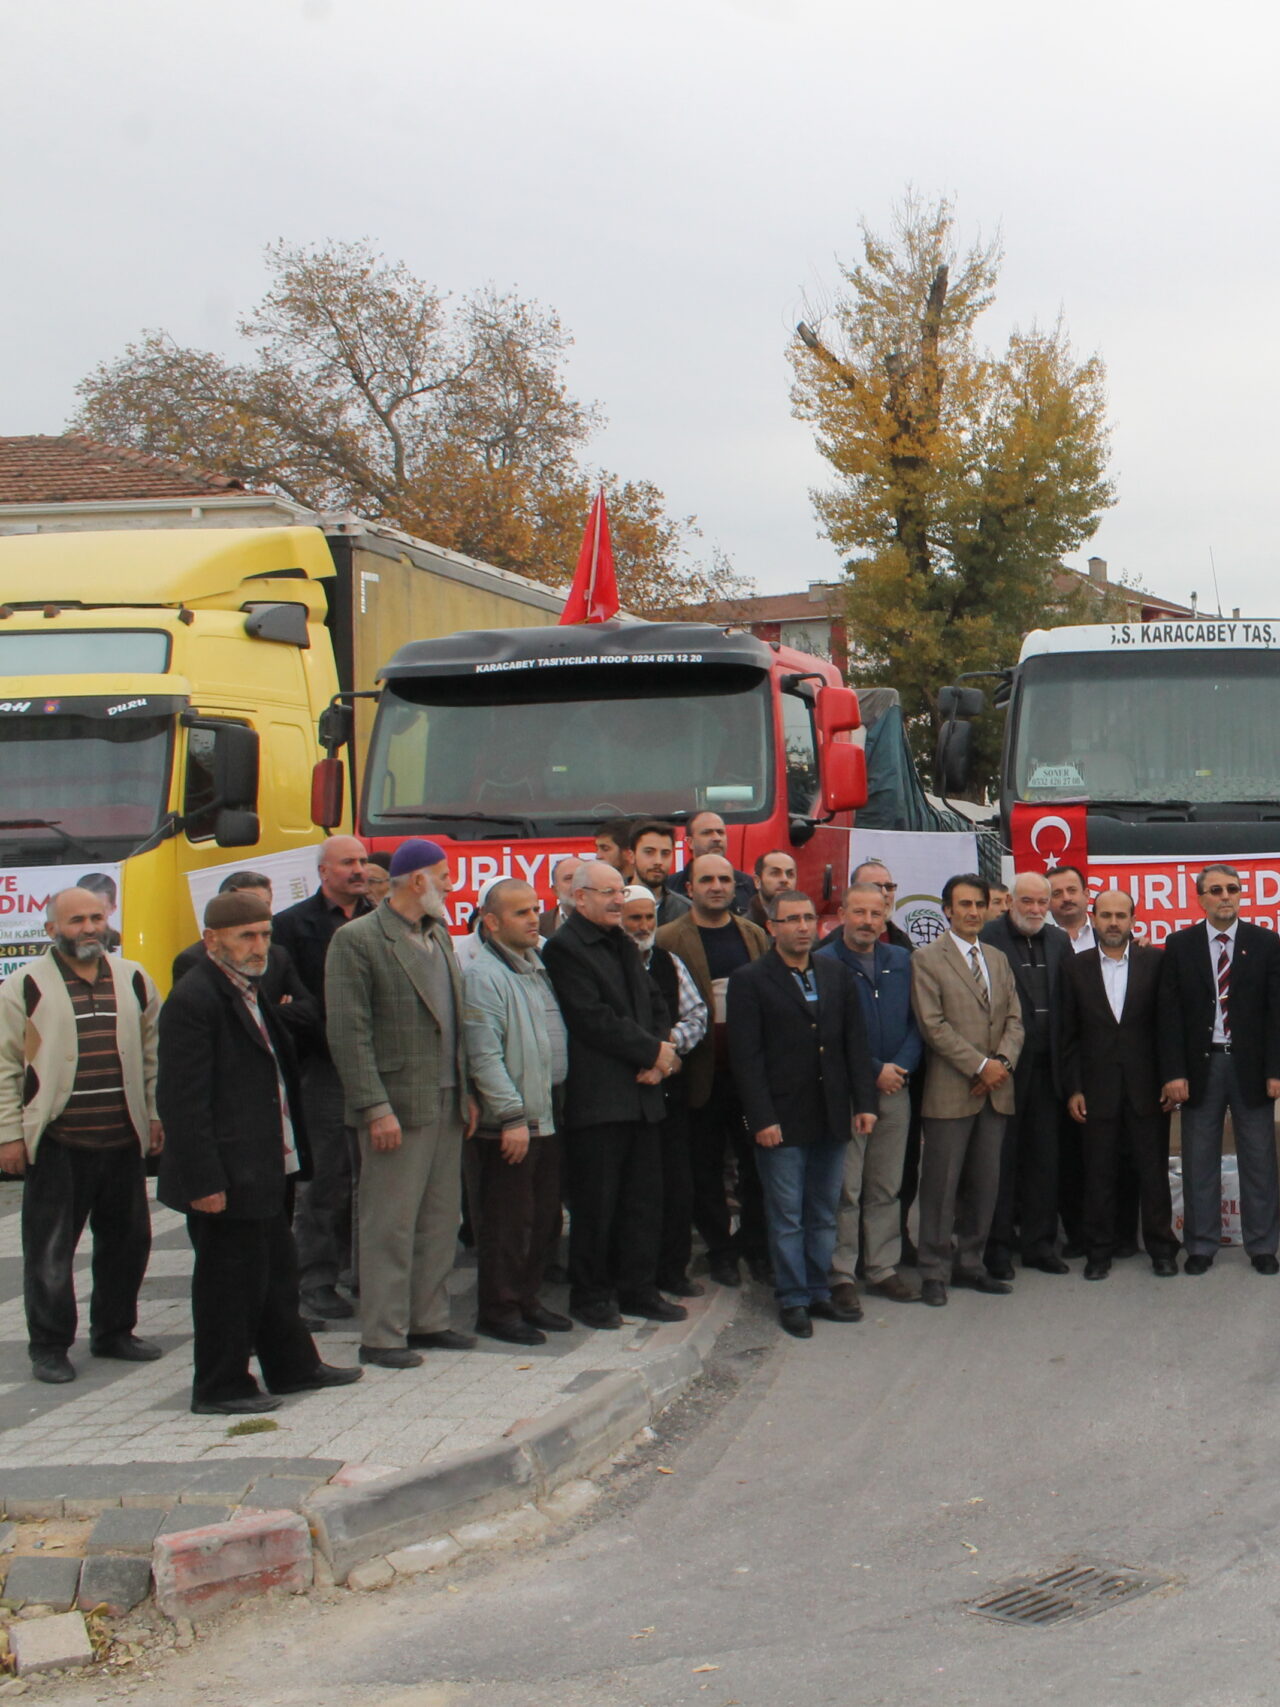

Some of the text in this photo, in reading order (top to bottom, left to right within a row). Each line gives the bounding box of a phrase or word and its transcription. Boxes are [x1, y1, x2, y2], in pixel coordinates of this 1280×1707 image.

[1141, 624, 1237, 643] KARACABEY
[475, 659, 536, 673] KARACABEY
[600, 655, 630, 664] KOOP
[631, 654, 656, 663] 0224
[676, 654, 690, 662] 12
[690, 654, 703, 663] 20
